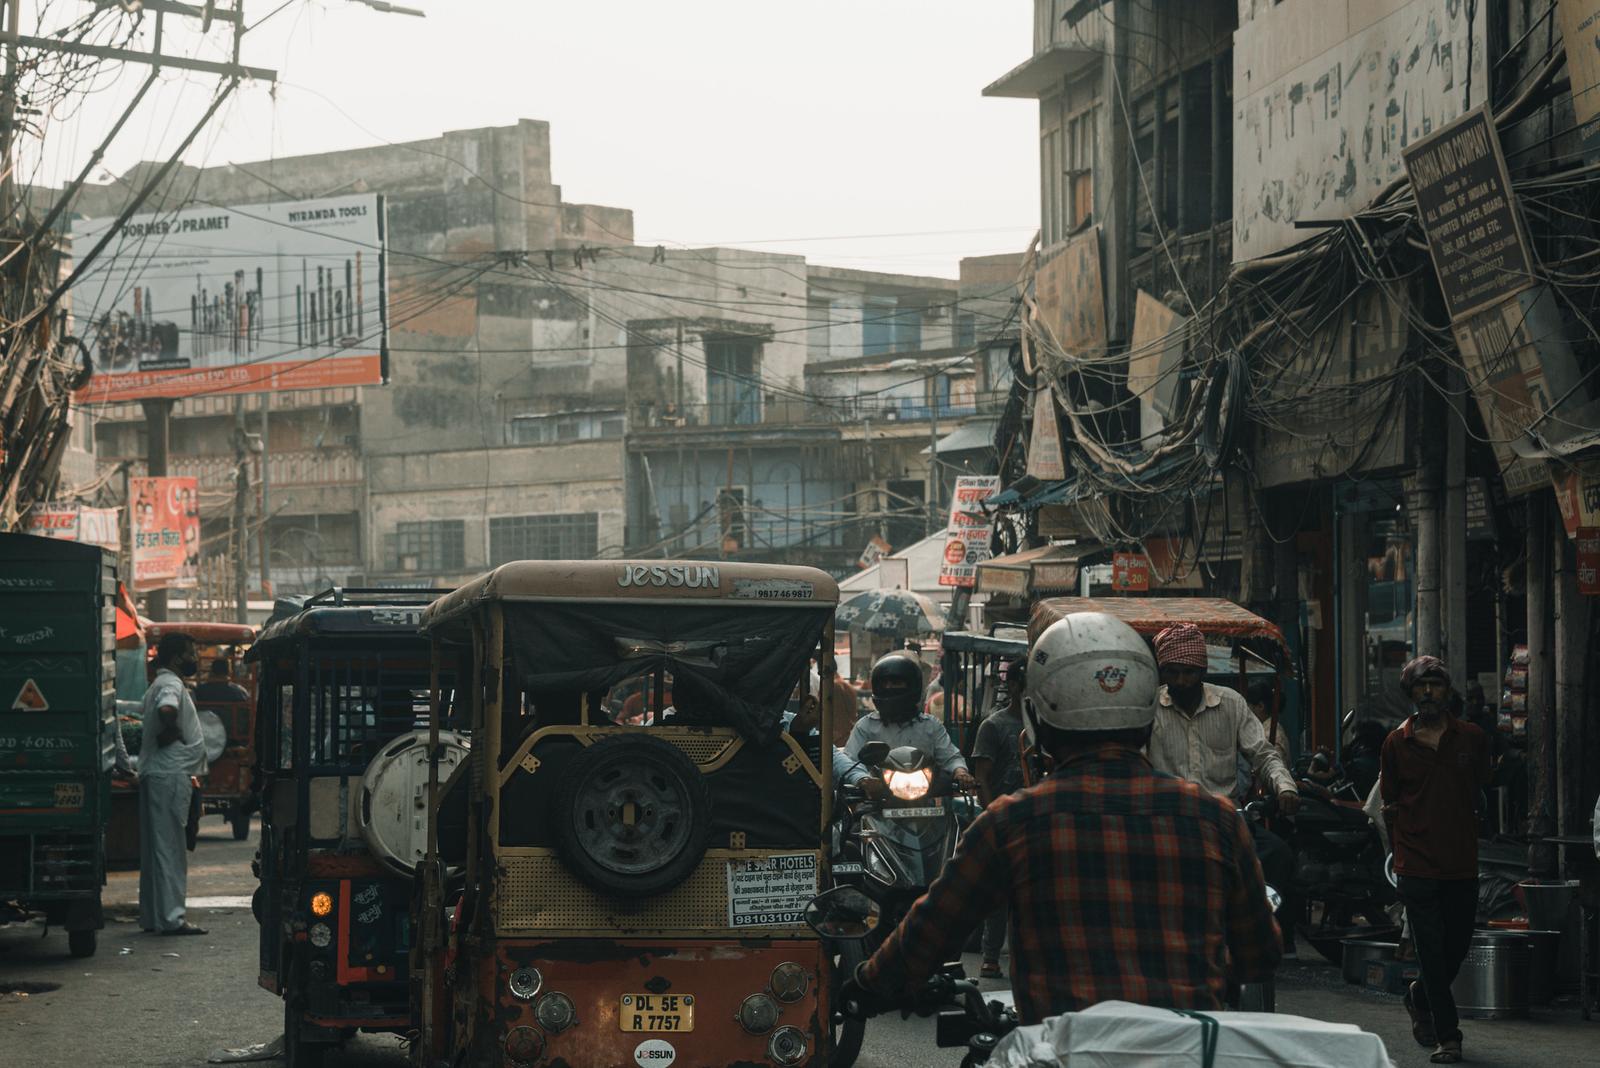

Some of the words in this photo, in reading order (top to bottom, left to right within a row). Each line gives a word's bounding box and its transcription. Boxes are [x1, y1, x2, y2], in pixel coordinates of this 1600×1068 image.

[1452, 123, 1489, 168] COMPANY
[1426, 208, 1438, 223] ALL
[1439, 199, 1457, 216] KINDS
[1457, 193, 1466, 207] OF
[1467, 181, 1489, 202] INDIAN
[289, 207, 336, 223] MIRANDA
[338, 205, 367, 218] TOOLS
[121, 221, 169, 237] DORMER
[182, 216, 230, 233] PRAMET
[1456, 234, 1468, 250] ART
[1469, 226, 1486, 243] CARD
[779, 856, 814, 869] HOTELS
[736, 913, 806, 924] 981031071
[636, 996, 653, 1011] DL
[661, 996, 678, 1011] 5E
[633, 1015, 642, 1030] R
[648, 1015, 680, 1030] 7757
